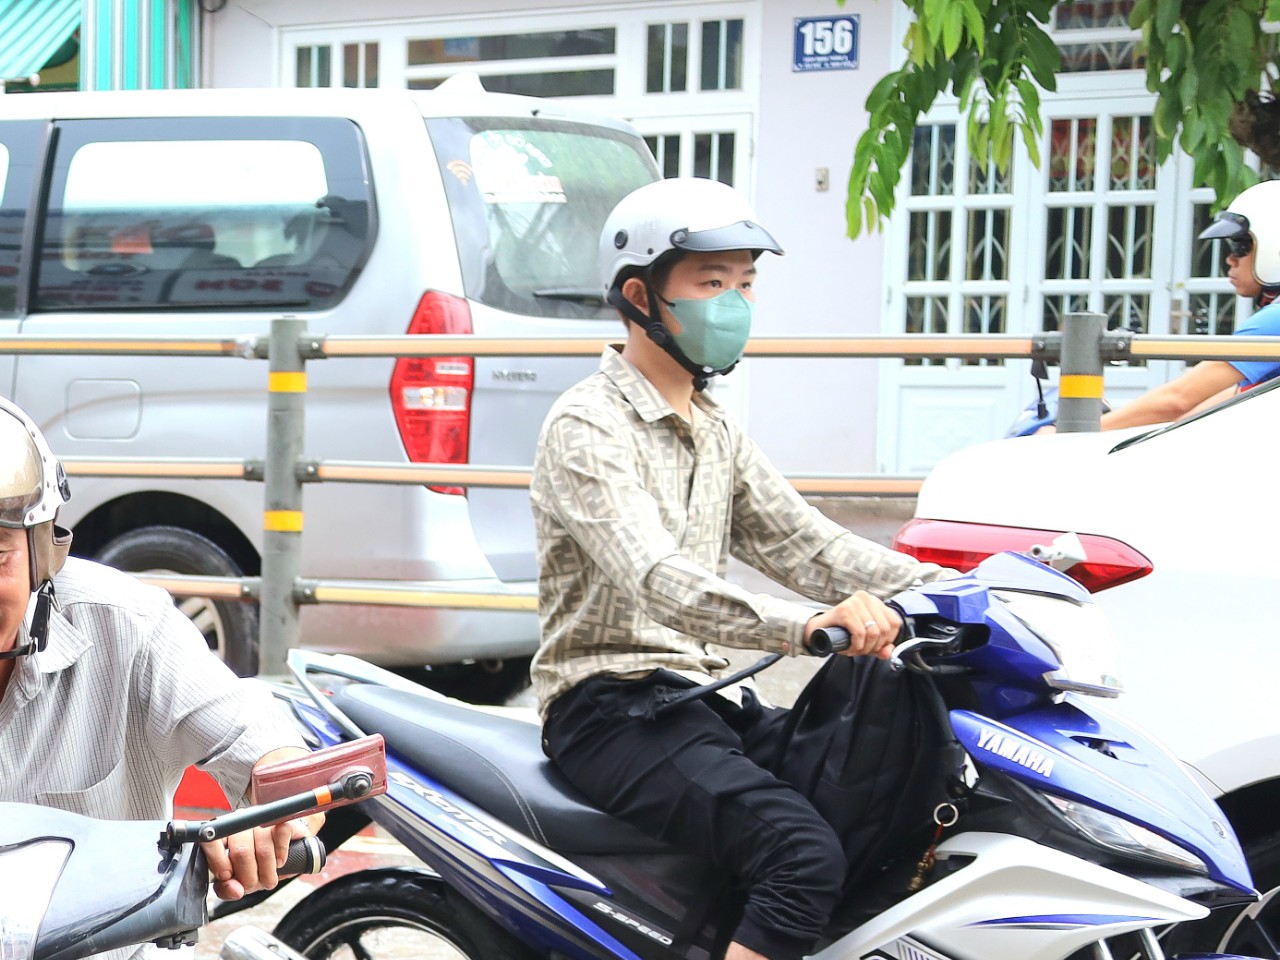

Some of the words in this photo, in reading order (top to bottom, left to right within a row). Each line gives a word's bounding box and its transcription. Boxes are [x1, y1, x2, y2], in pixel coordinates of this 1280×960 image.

[800, 19, 853, 56] 156
[976, 728, 1056, 779] YAMAHA
[592, 902, 673, 945] S-SPEED
